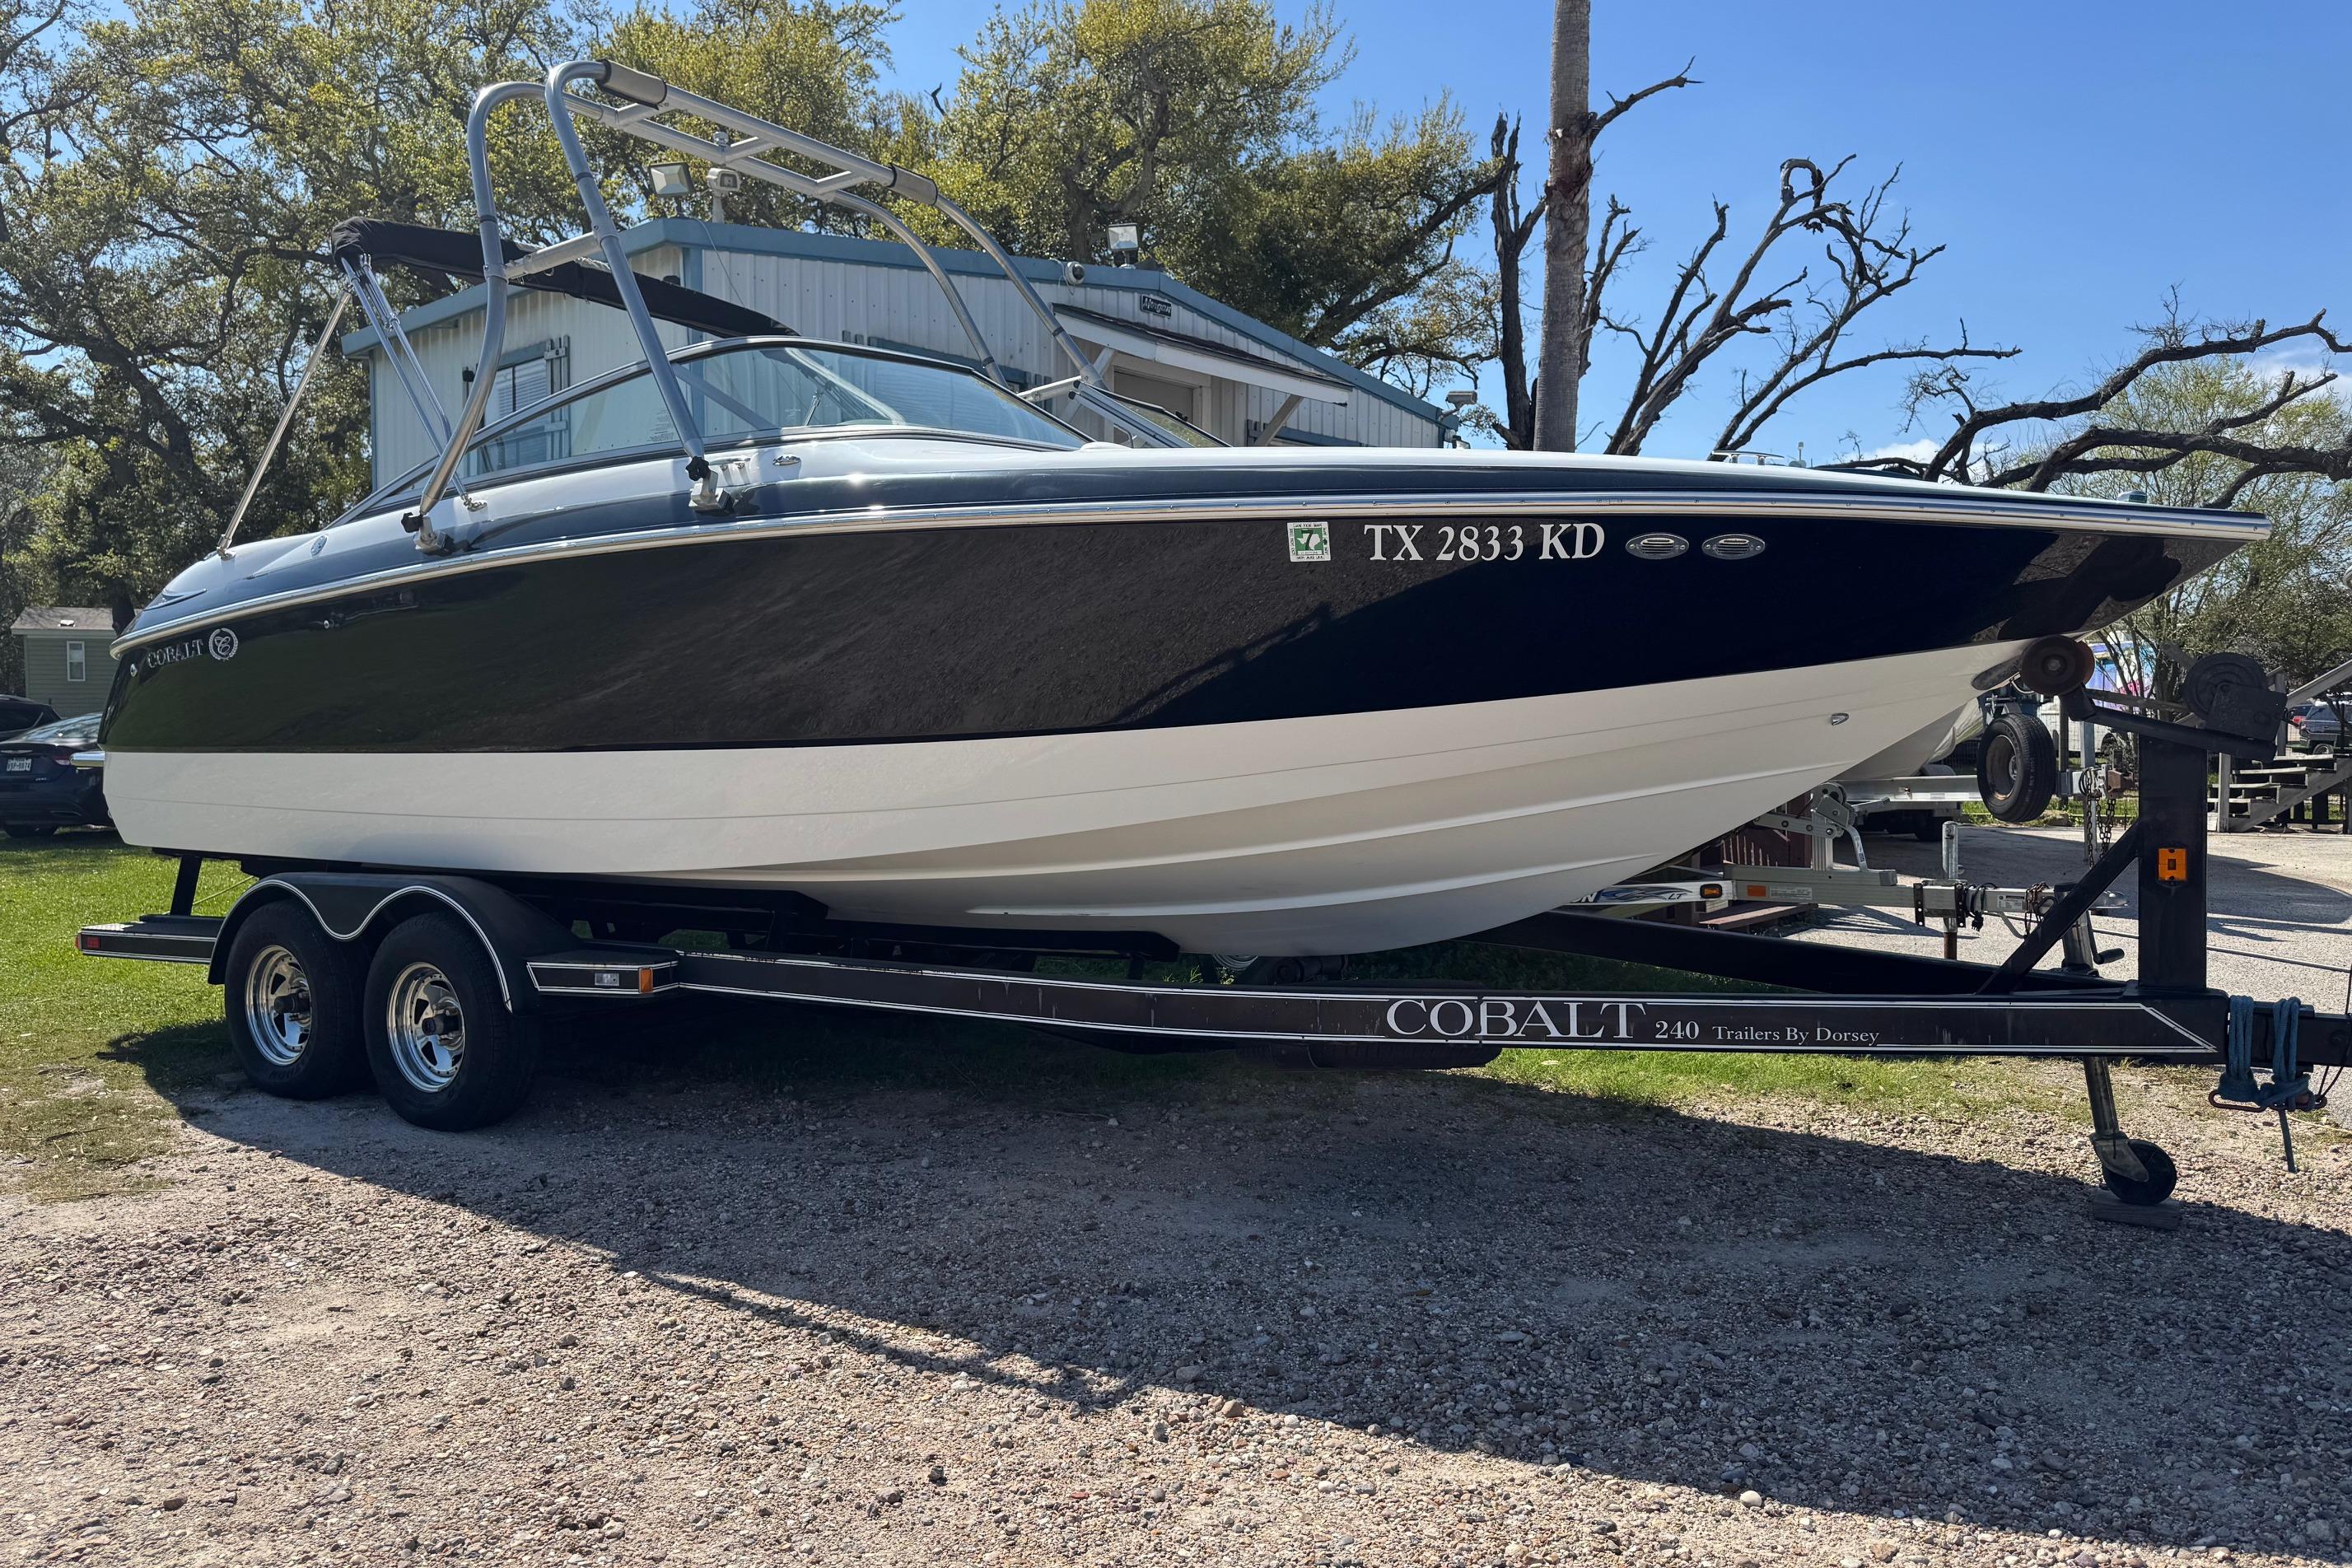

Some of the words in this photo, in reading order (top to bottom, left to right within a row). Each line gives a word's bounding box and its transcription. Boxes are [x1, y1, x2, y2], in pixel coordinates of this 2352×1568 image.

[1301, 530, 1314, 550] 7
[1364, 524, 1424, 561] TX
[1435, 525, 1524, 562] 2833
[1538, 522, 1605, 560] KD
[147, 638, 203, 669] COBALT
[1668, 892, 1687, 900] LT
[1386, 999, 1646, 1038] COBALT
[1654, 1020, 1700, 1040] 240
[1711, 1025, 1780, 1041] Trailers
[1785, 1026, 1809, 1046] By
[1815, 1026, 1880, 1047] Dorsey
